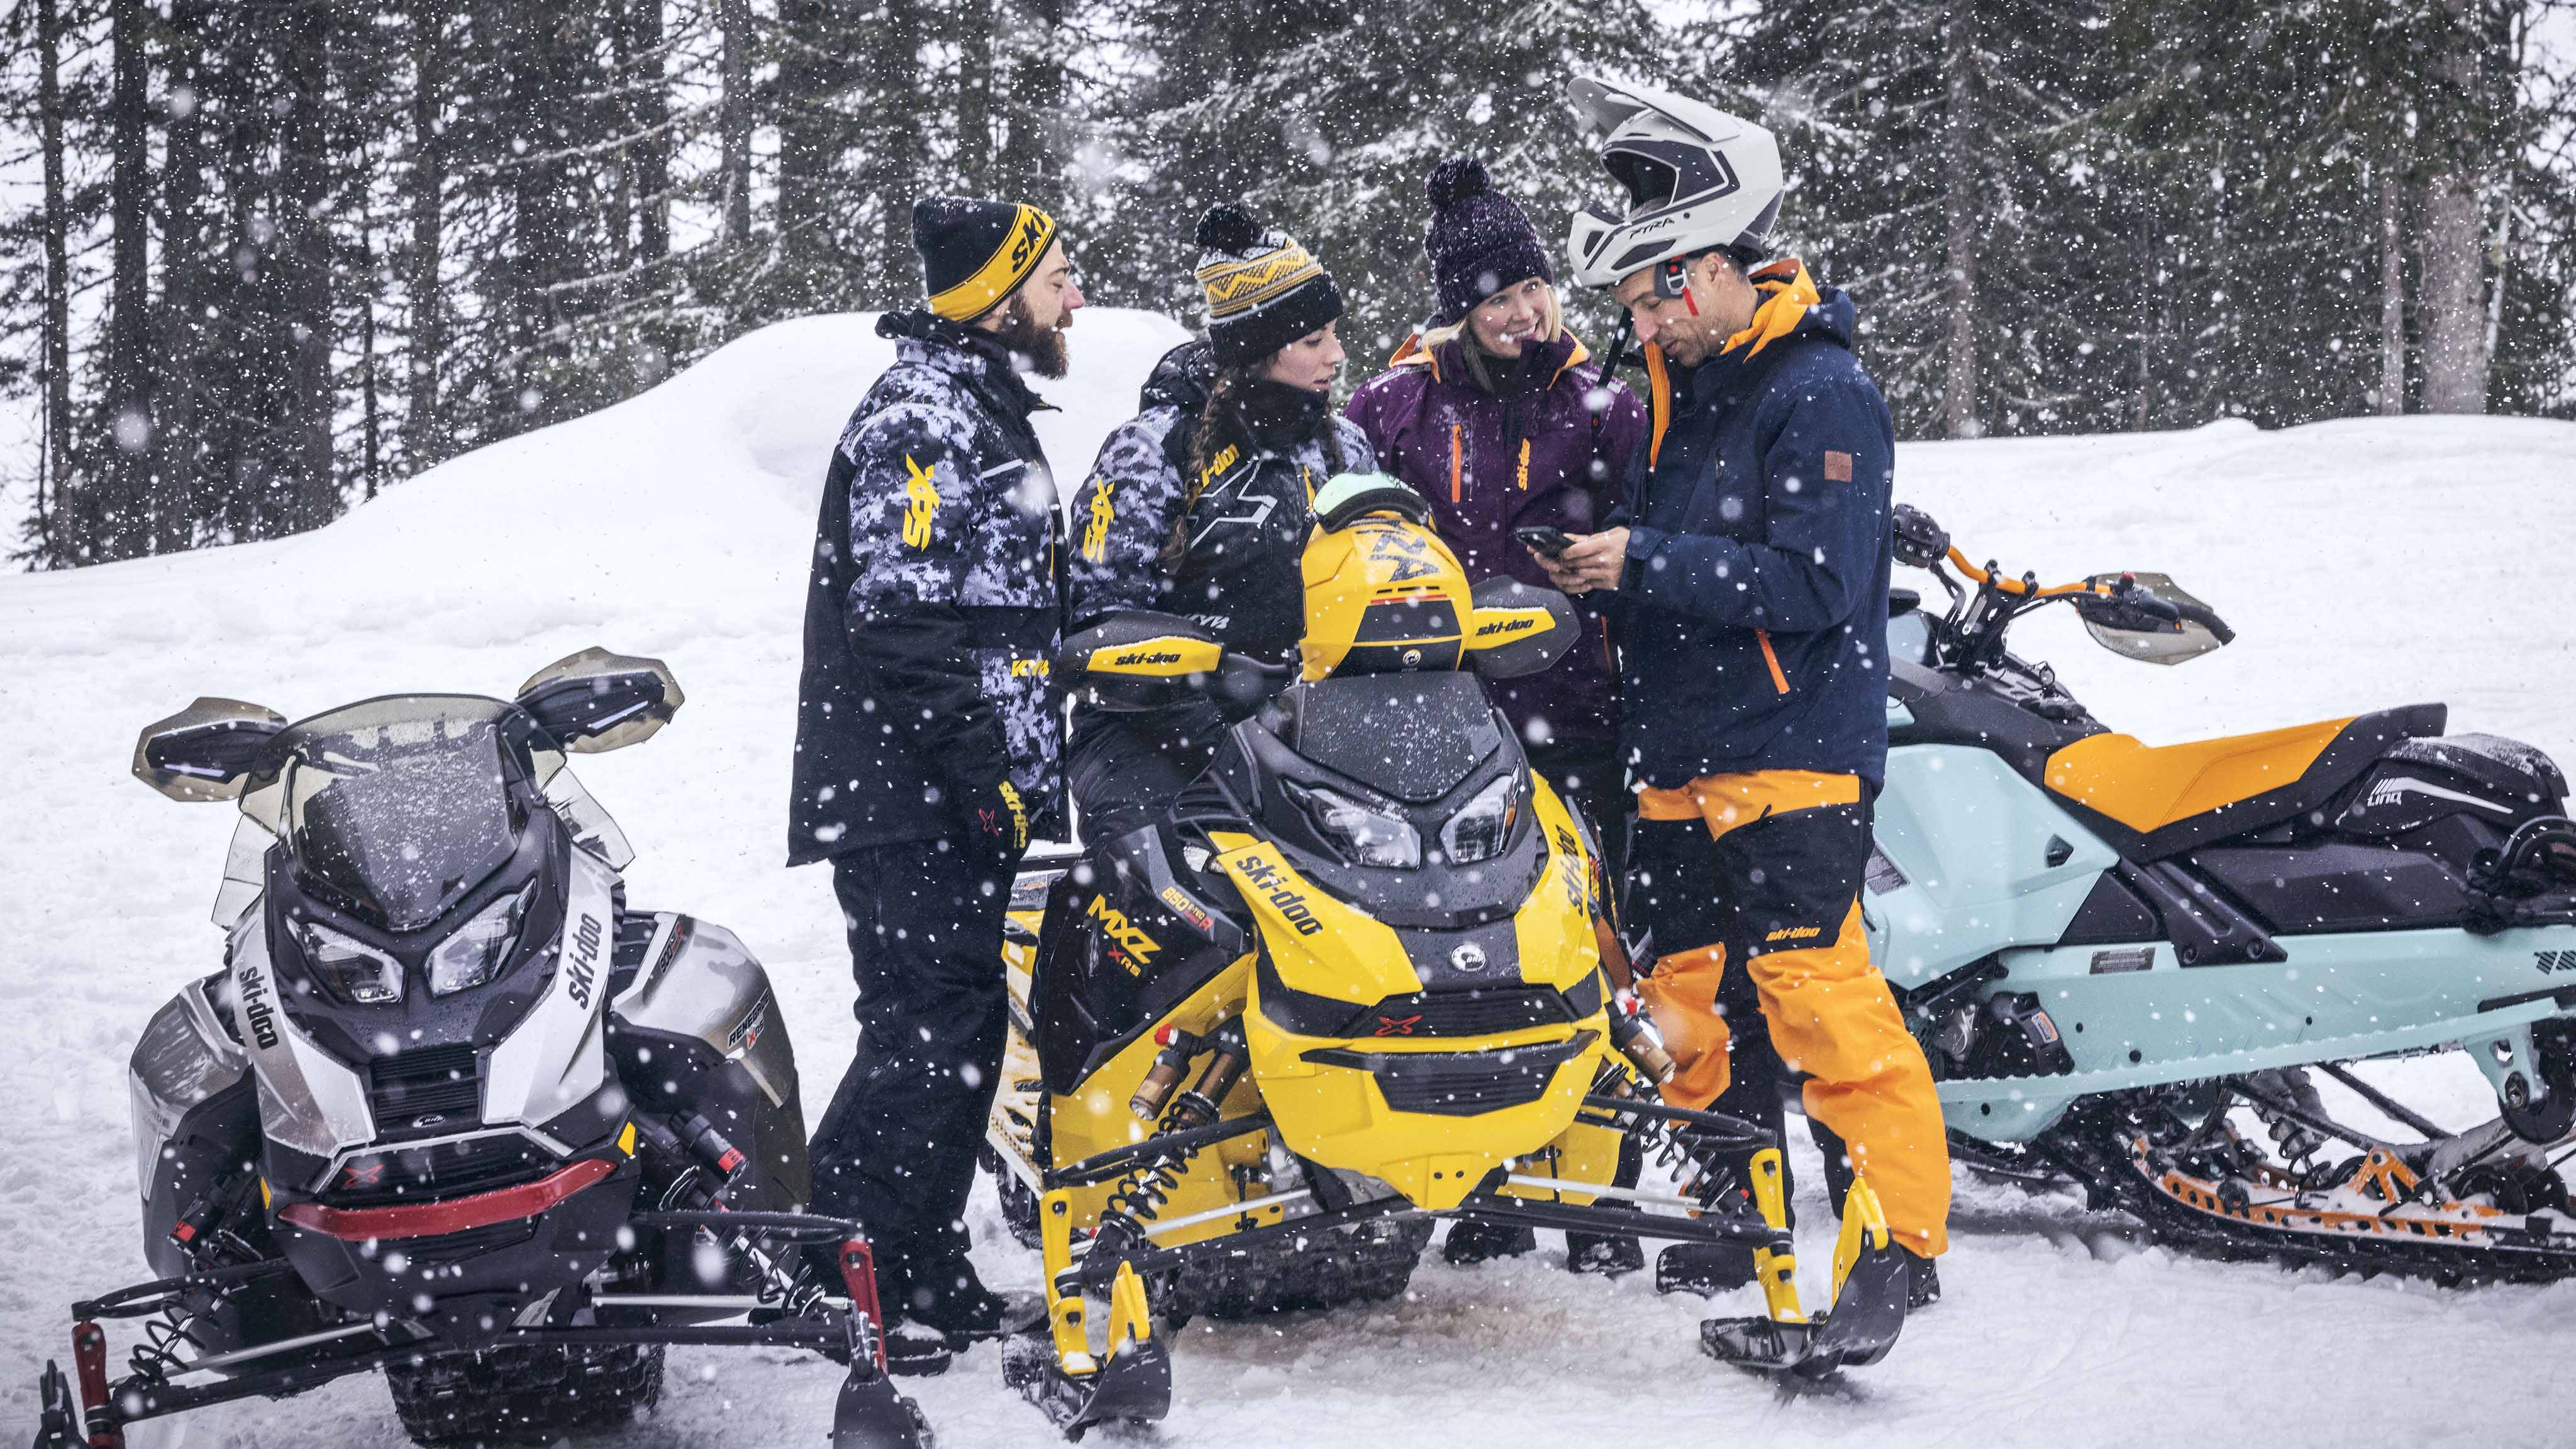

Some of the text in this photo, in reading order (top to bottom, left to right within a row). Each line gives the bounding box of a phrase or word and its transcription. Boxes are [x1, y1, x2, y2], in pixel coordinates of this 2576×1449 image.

[1476, 619, 1535, 636] ski-doo
[1011, 659, 1049, 677] KYB
[1115, 652, 1182, 665] ski-doo
[1162, 886, 1190, 911] 850
[1236, 856, 1323, 936] ski-doo
[1087, 893, 1162, 963] MXZ
[1766, 926, 1821, 941] ski-doo
[567, 913, 601, 1010] ski-doo
[239, 966, 279, 1050] ski-doo
[729, 989, 770, 1047] RENEGADE
